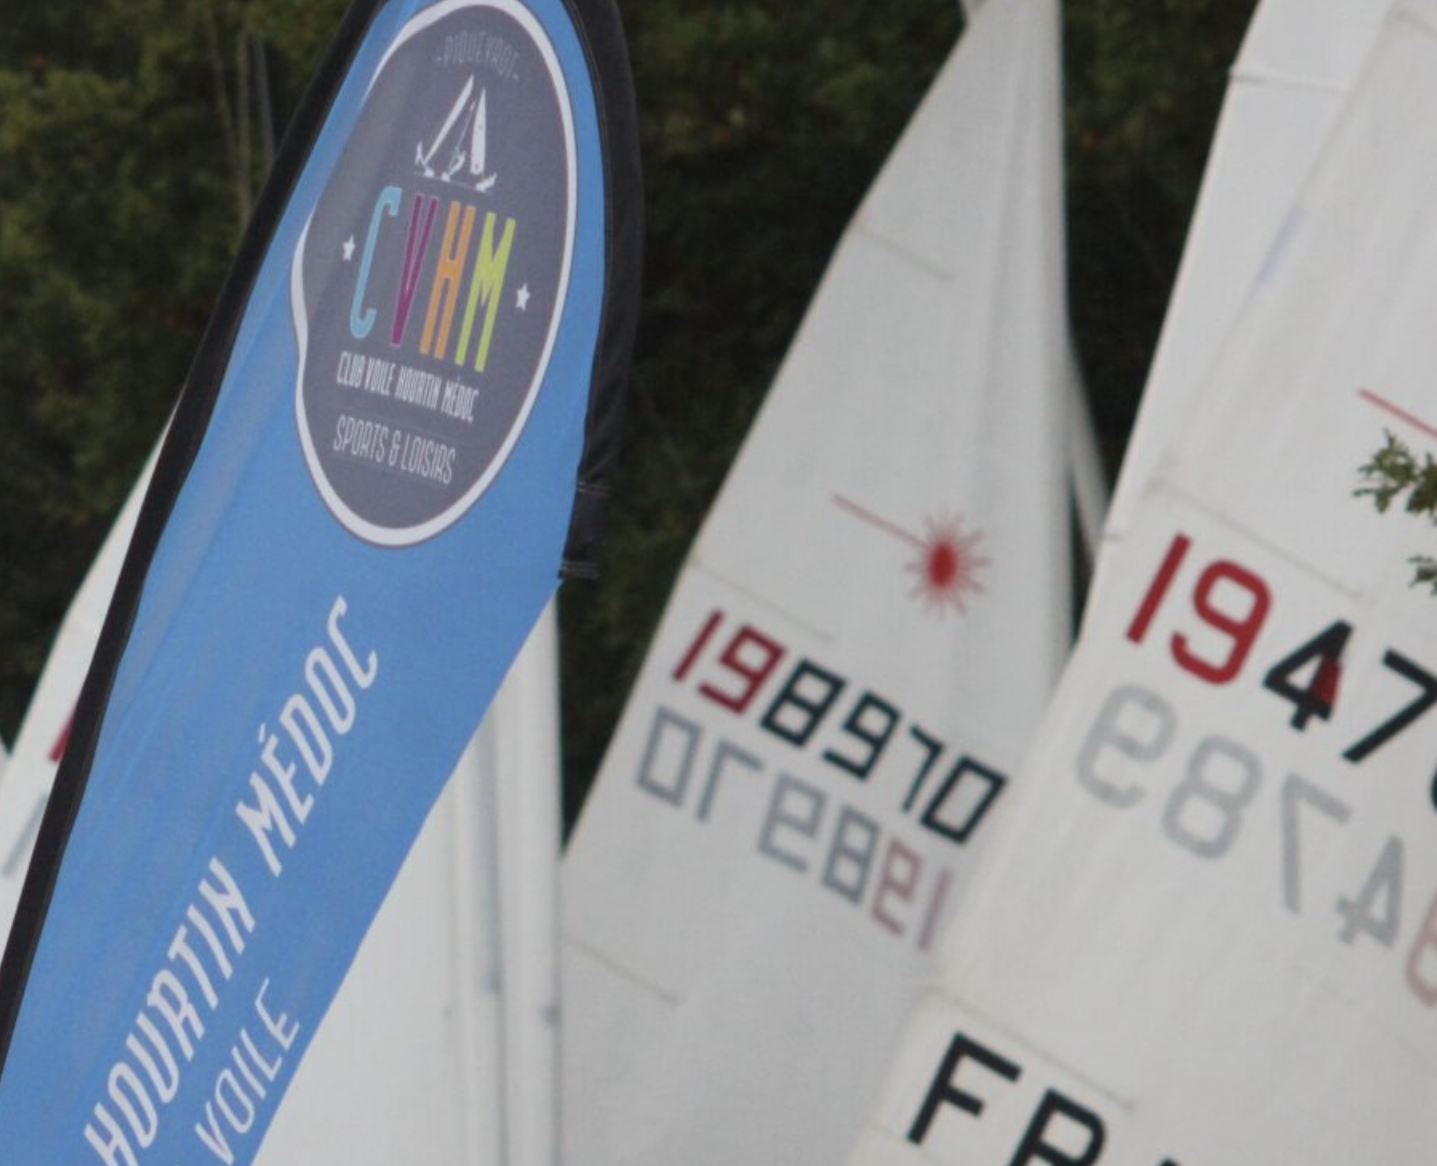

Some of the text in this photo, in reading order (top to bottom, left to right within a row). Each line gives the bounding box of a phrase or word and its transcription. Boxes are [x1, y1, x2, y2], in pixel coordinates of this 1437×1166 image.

[350, 186, 516, 372] CVHM
[333, 414, 457, 485] SPORTS & LOISIRS
[336, 351, 480, 424] CLUB VOILE HOURTIN MÉDOC
[672, 609, 1009, 845] 198970
[1126, 532, 1437, 812] 1947
[84, 594, 378, 1166] HOURTIN MÉDOC
[195, 977, 300, 1166] VOILE
